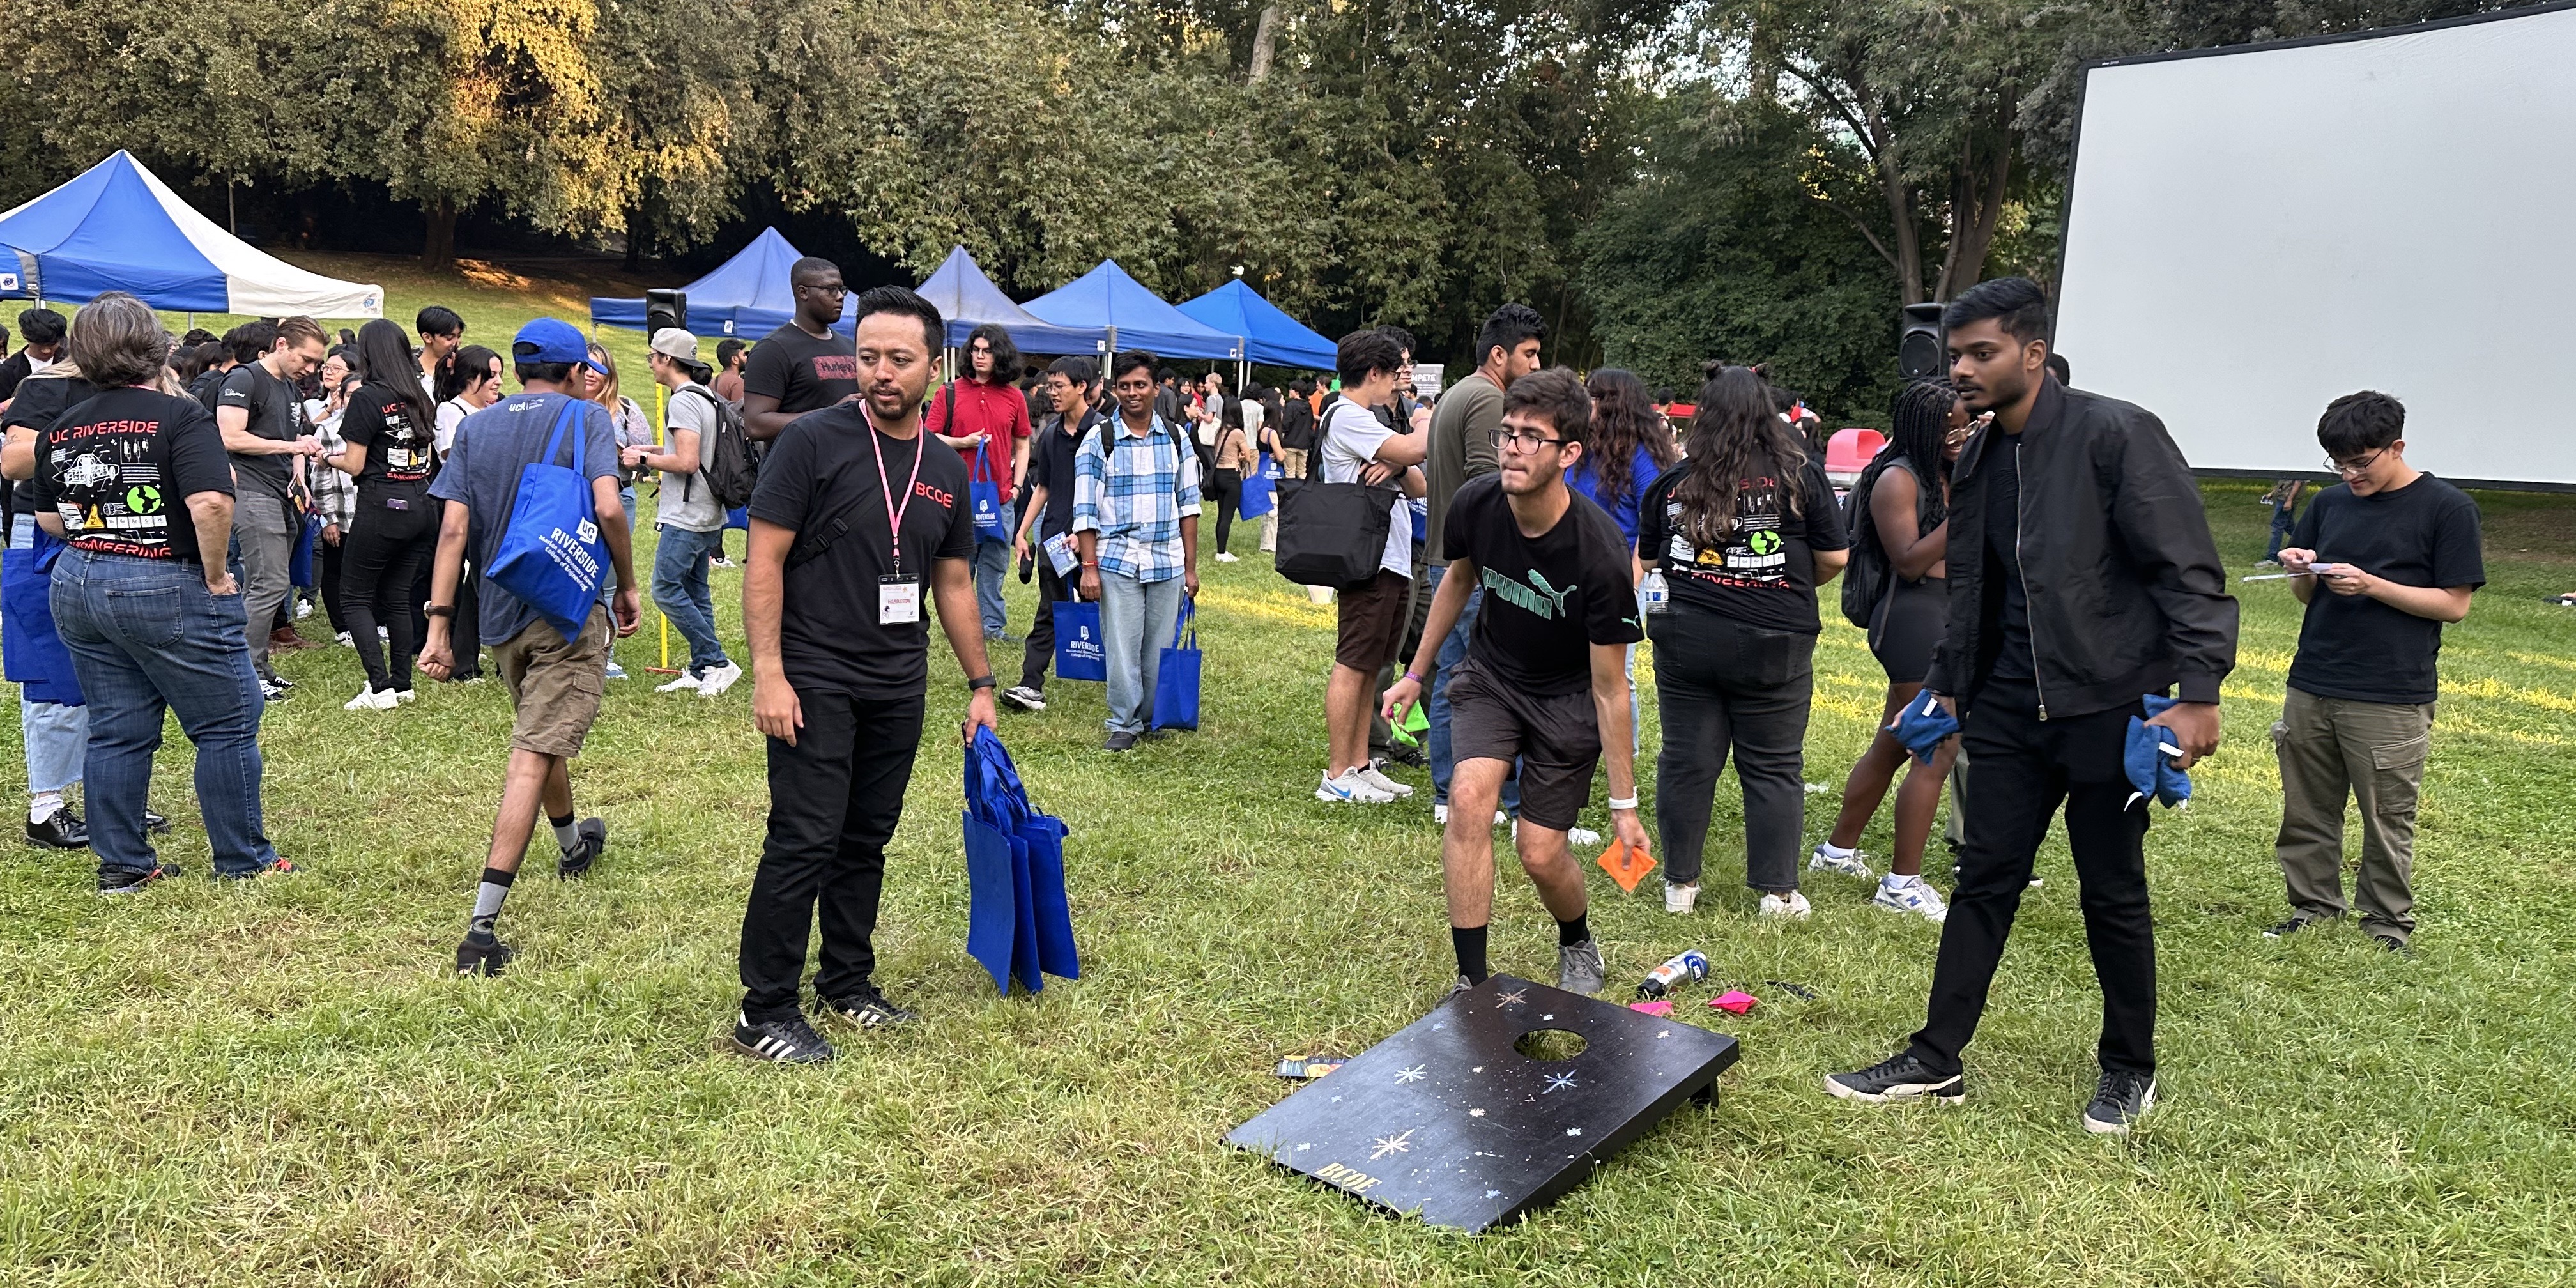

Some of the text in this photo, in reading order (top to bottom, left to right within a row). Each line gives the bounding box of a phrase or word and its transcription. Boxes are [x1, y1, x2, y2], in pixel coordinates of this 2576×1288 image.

[382, 403, 398, 413] UC
[509, 402, 526, 412] UCR
[49, 420, 159, 443] UC RIVERSIDE
[916, 482, 953, 509] BCOE
[538, 535, 558, 550] Marian
[556, 549, 567, 558] and
[565, 555, 585, 578] Rosemary
[551, 527, 599, 579] RIVERSIDE
[544, 546, 562, 564] College
[564, 565, 588, 592] Engineering
[1482, 565, 1552, 620] PUMA
[1314, 1162, 1383, 1193] BCOE
